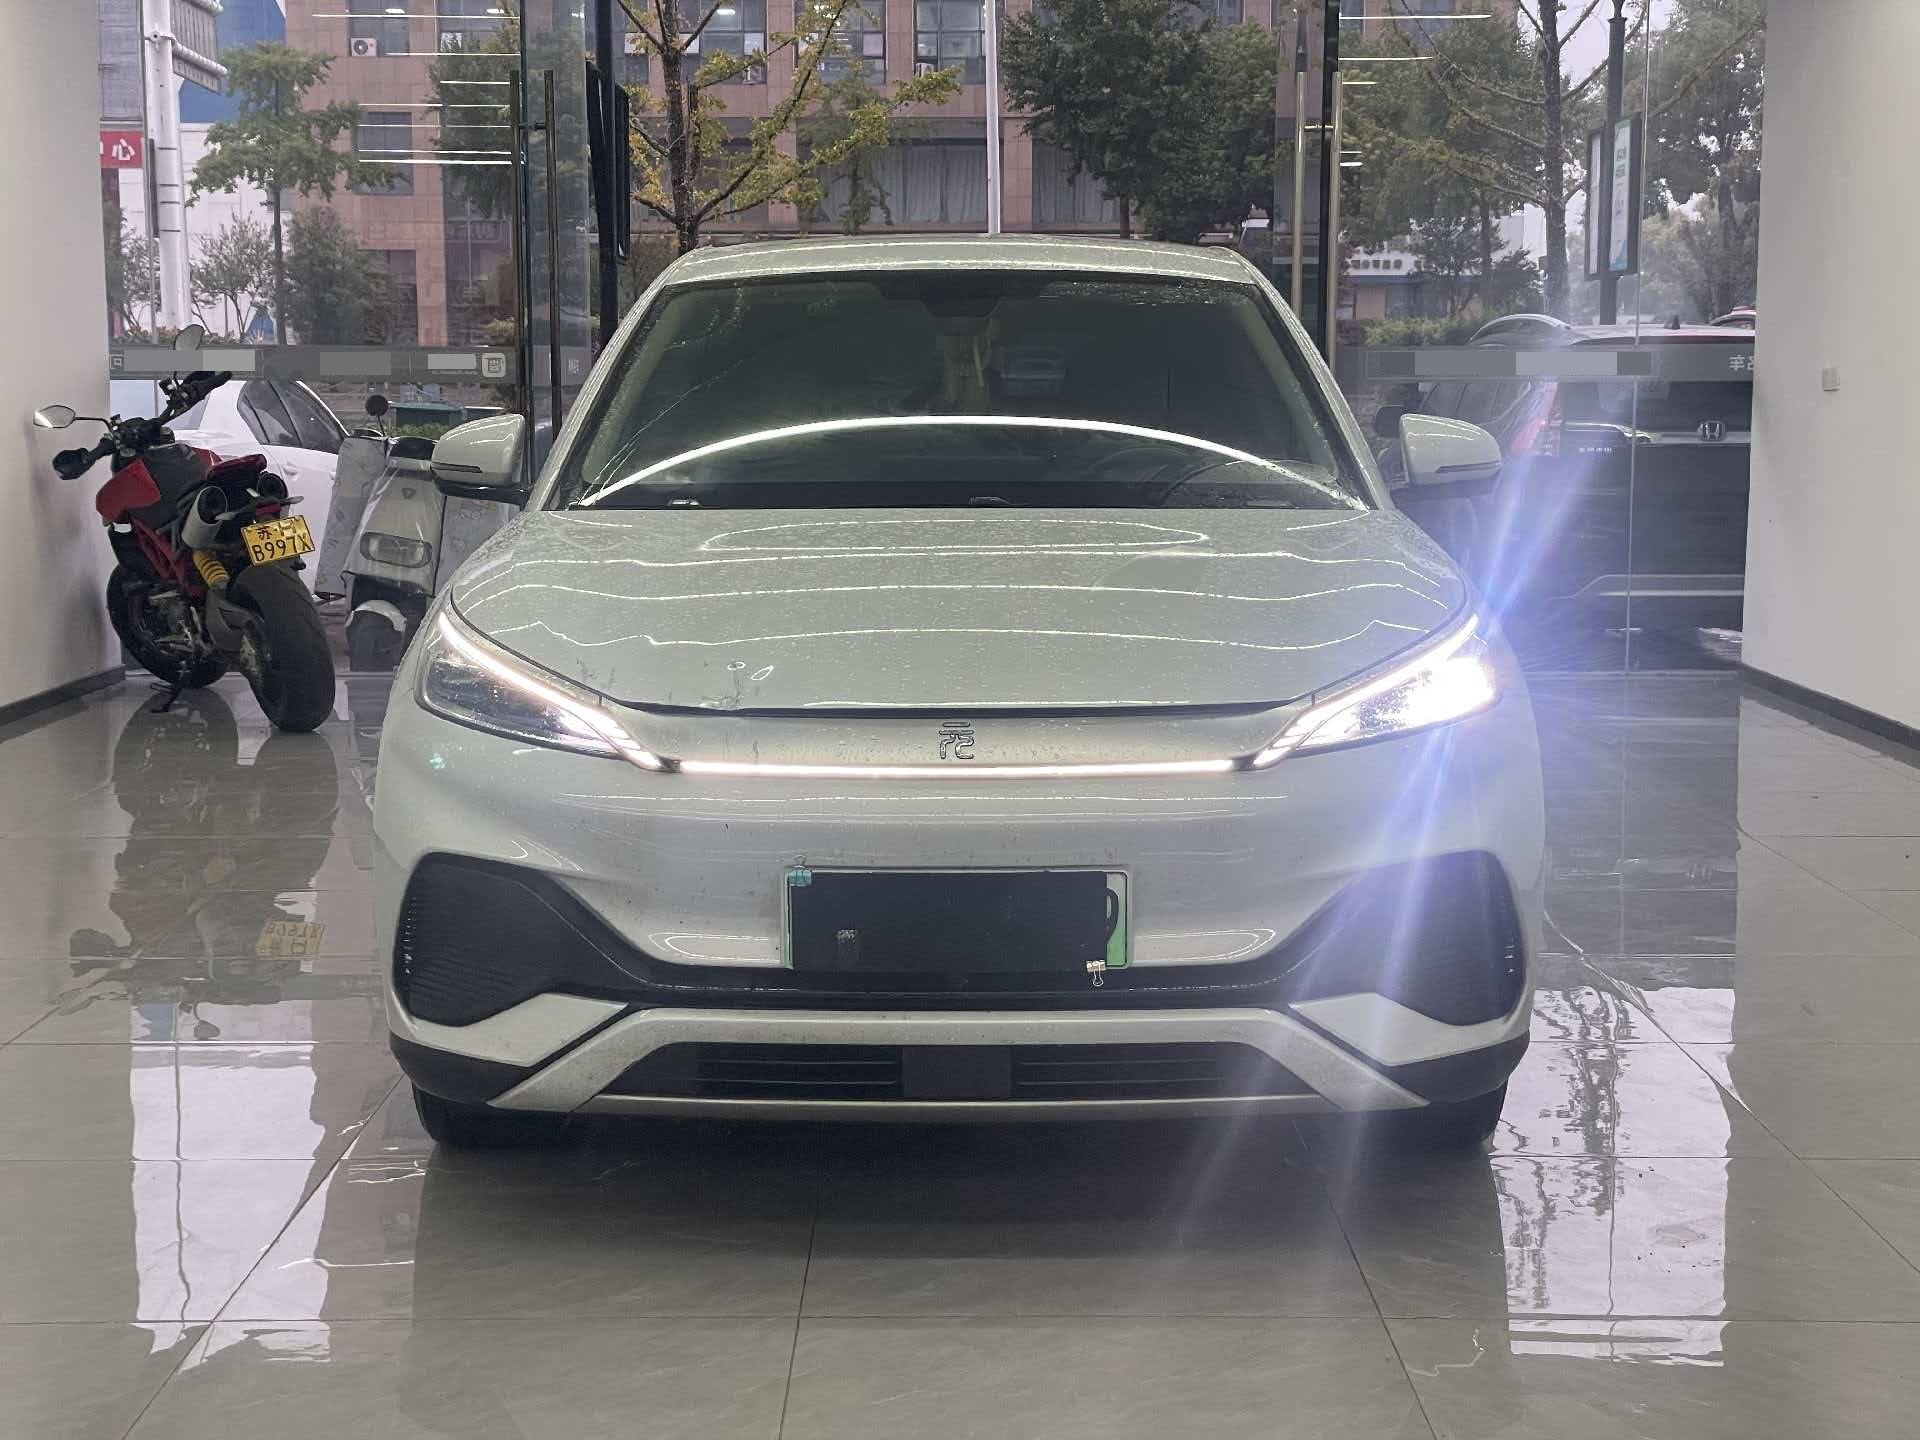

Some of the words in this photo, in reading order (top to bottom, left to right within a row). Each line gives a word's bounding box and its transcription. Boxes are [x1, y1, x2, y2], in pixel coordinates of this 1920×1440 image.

[100, 138, 136, 161] 心
[252, 532, 312, 562] B997X
[939, 722, 975, 760] 元
